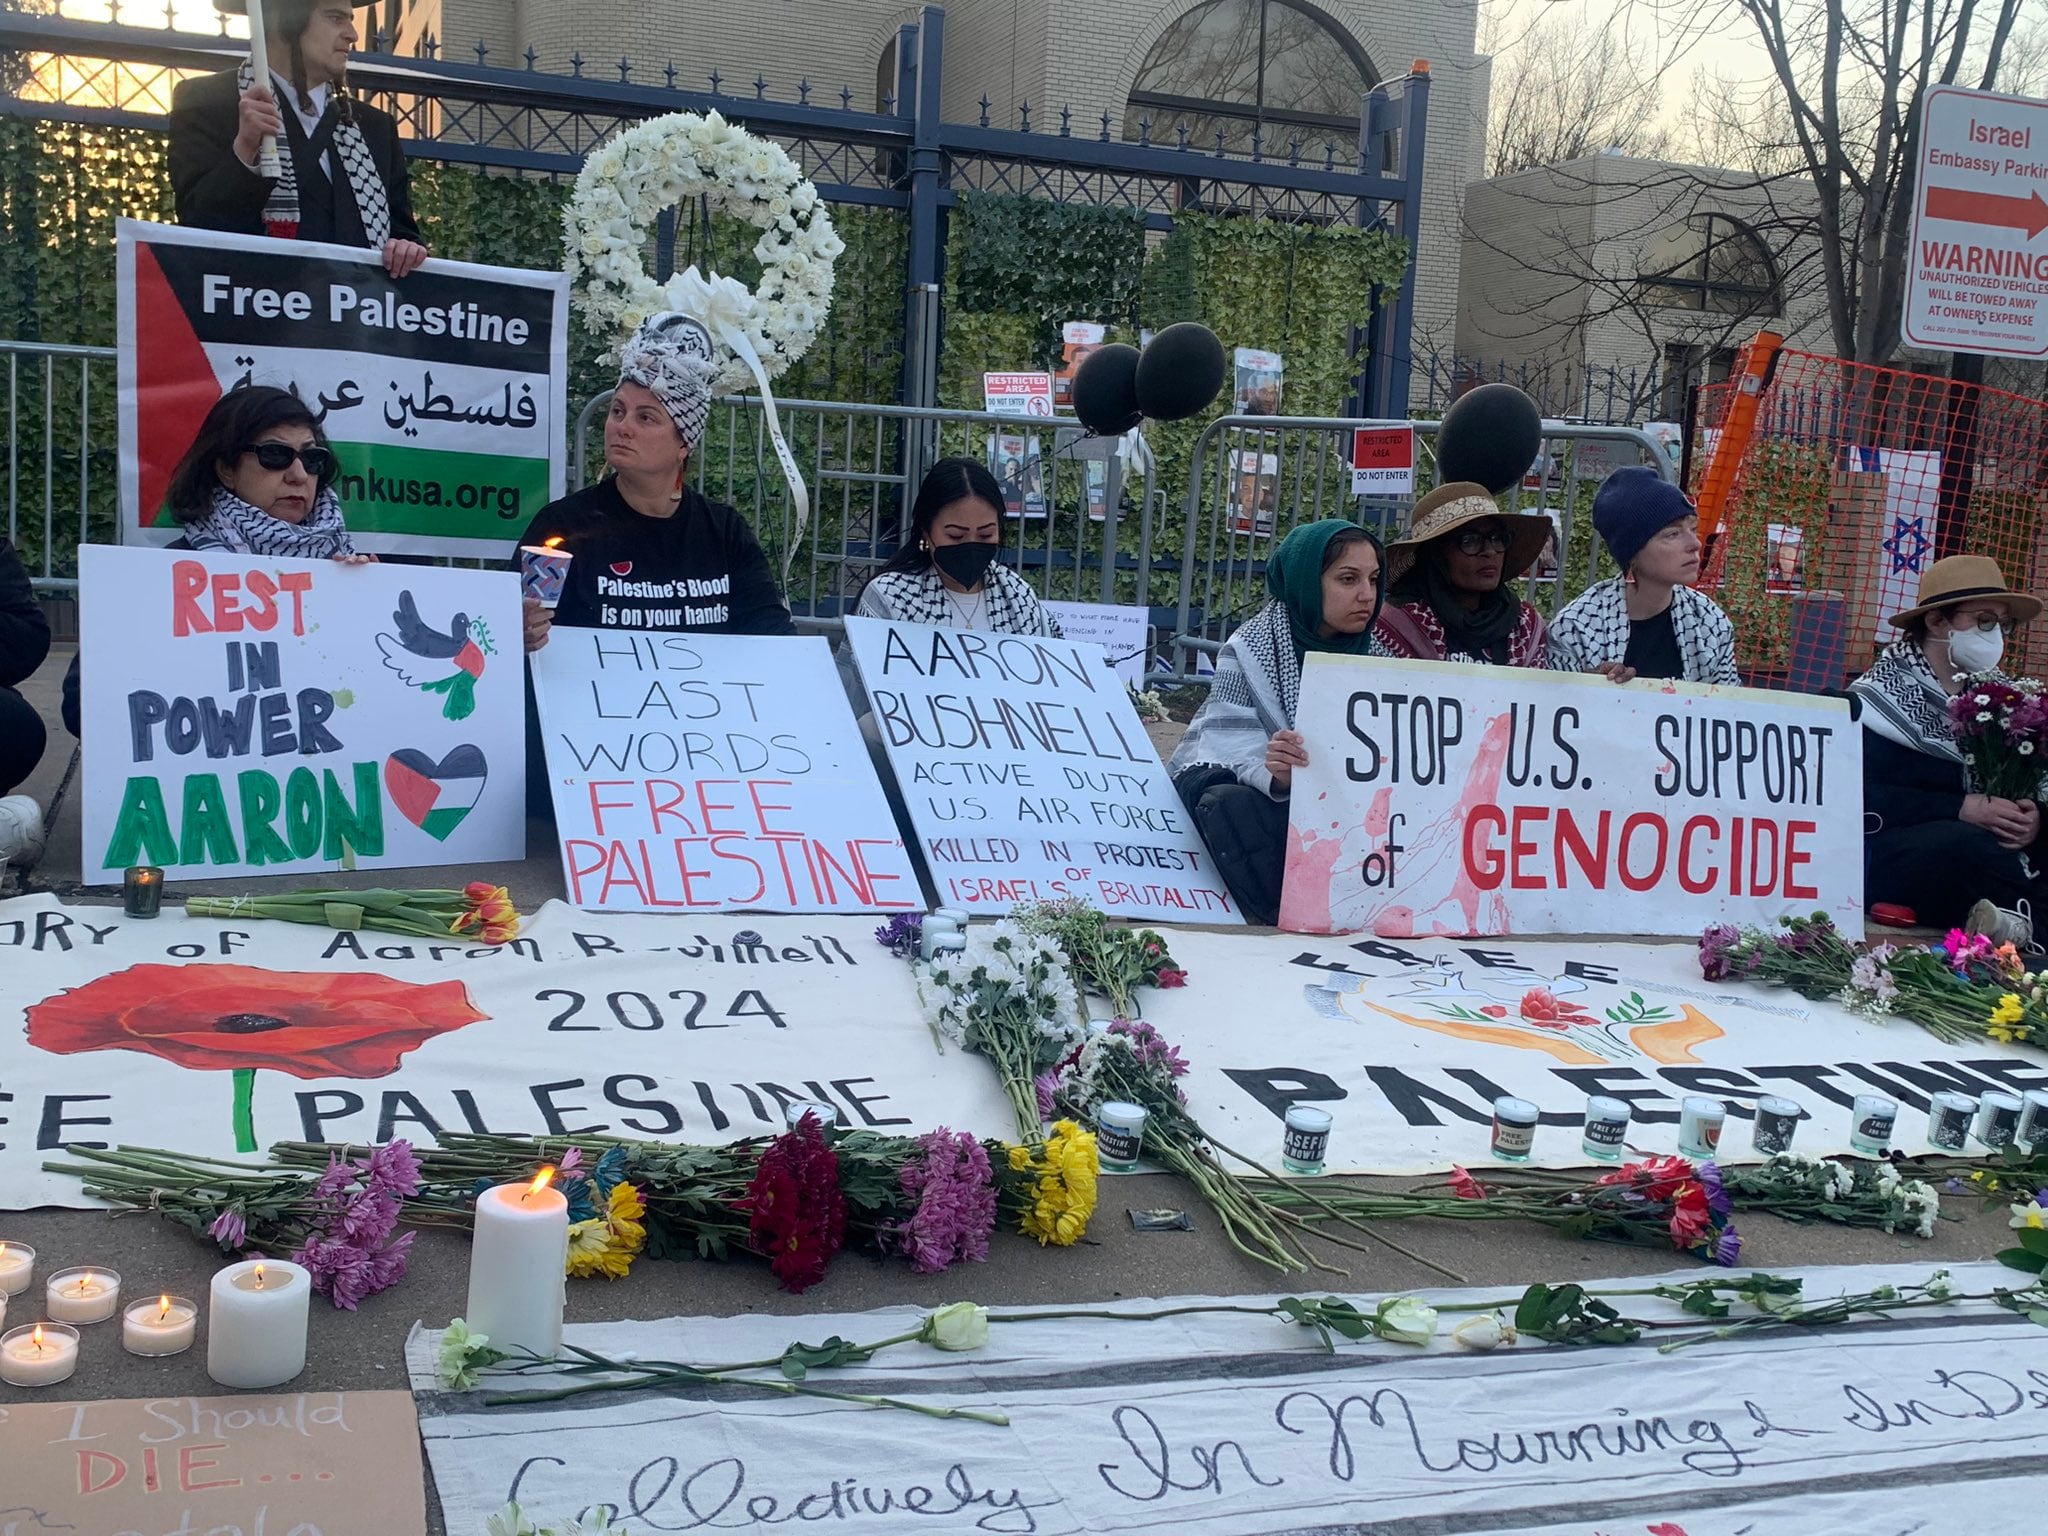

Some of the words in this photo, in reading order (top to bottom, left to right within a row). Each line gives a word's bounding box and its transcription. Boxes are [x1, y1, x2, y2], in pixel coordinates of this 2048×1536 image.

[1969, 119, 2031, 149] Israel
[1929, 148, 1999, 176] Embassy
[1922, 240, 2048, 281] WARNING
[1919, 270, 2000, 289] UNAUTHORIZED
[203, 274, 311, 320] Free
[330, 284, 529, 346] Palestine
[1928, 288, 1952, 301] WILL
[1954, 291, 1967, 302] BE
[1969, 293, 2006, 306] TOWED
[2008, 297, 2037, 309] AWAY
[1928, 305, 1941, 315] AT
[1943, 306, 1987, 321] OWNERS
[1989, 312, 2034, 326] EXPENSE
[988, 376, 1047, 385] RESTRICTED
[1005, 385, 1031, 393] AREA
[384, 370, 537, 437] فلسطين
[1362, 435, 1403, 445] RESTRICTED
[1371, 449, 1390, 458] AREA
[1357, 471, 1367, 480] DO
[1369, 471, 1384, 480] NOT
[1386, 471, 1409, 480] ENTER
[173, 560, 312, 638] REST
[597, 576, 687, 598] Palestine's
[687, 574, 730, 598] Blood
[601, 604, 617, 624] is
[621, 608, 642, 626] on
[645, 609, 682, 628] your
[685, 603, 729, 625] hands
[595, 634, 703, 671] HIS
[882, 628, 1097, 693] AARON
[1111, 642, 1136, 651] HANDS
[226, 641, 281, 692] IN
[591, 680, 765, 722] LAST
[129, 687, 344, 762] POWER
[873, 690, 1153, 764] BUSHNELL
[1345, 691, 1462, 786] STOP
[1506, 702, 1592, 791] U.S.
[1654, 714, 1833, 806] SUPPORT
[913, 761, 1035, 788] ACTIVE
[1063, 767, 1153, 797] DUTY
[102, 761, 384, 869] AARON
[928, 797, 993, 821] U.S.
[1018, 797, 1080, 825] AIR
[1092, 801, 1184, 834] FORCE
[927, 838, 1019, 863] KILLED
[1043, 839, 1071, 862] IN
[1098, 842, 1200, 871] PROTEST
[1361, 813, 1406, 888] of
[1463, 803, 1818, 899] GENOCIDE
[1065, 867, 1092, 881] OF
[1098, 880, 1232, 913] BRUTALITY
[1288, 940, 1619, 984] FREE
[534, 989, 787, 1032] 2024
[1100, 1132, 1131, 1148] ALESTINE.
[1500, 1137, 1528, 1146] PALEST
[47, 1402, 107, 1444] I
[139, 1392, 352, 1444] Should
[1098, 1405, 1284, 1501] In
[1276, 1389, 1760, 1482] Mourning
